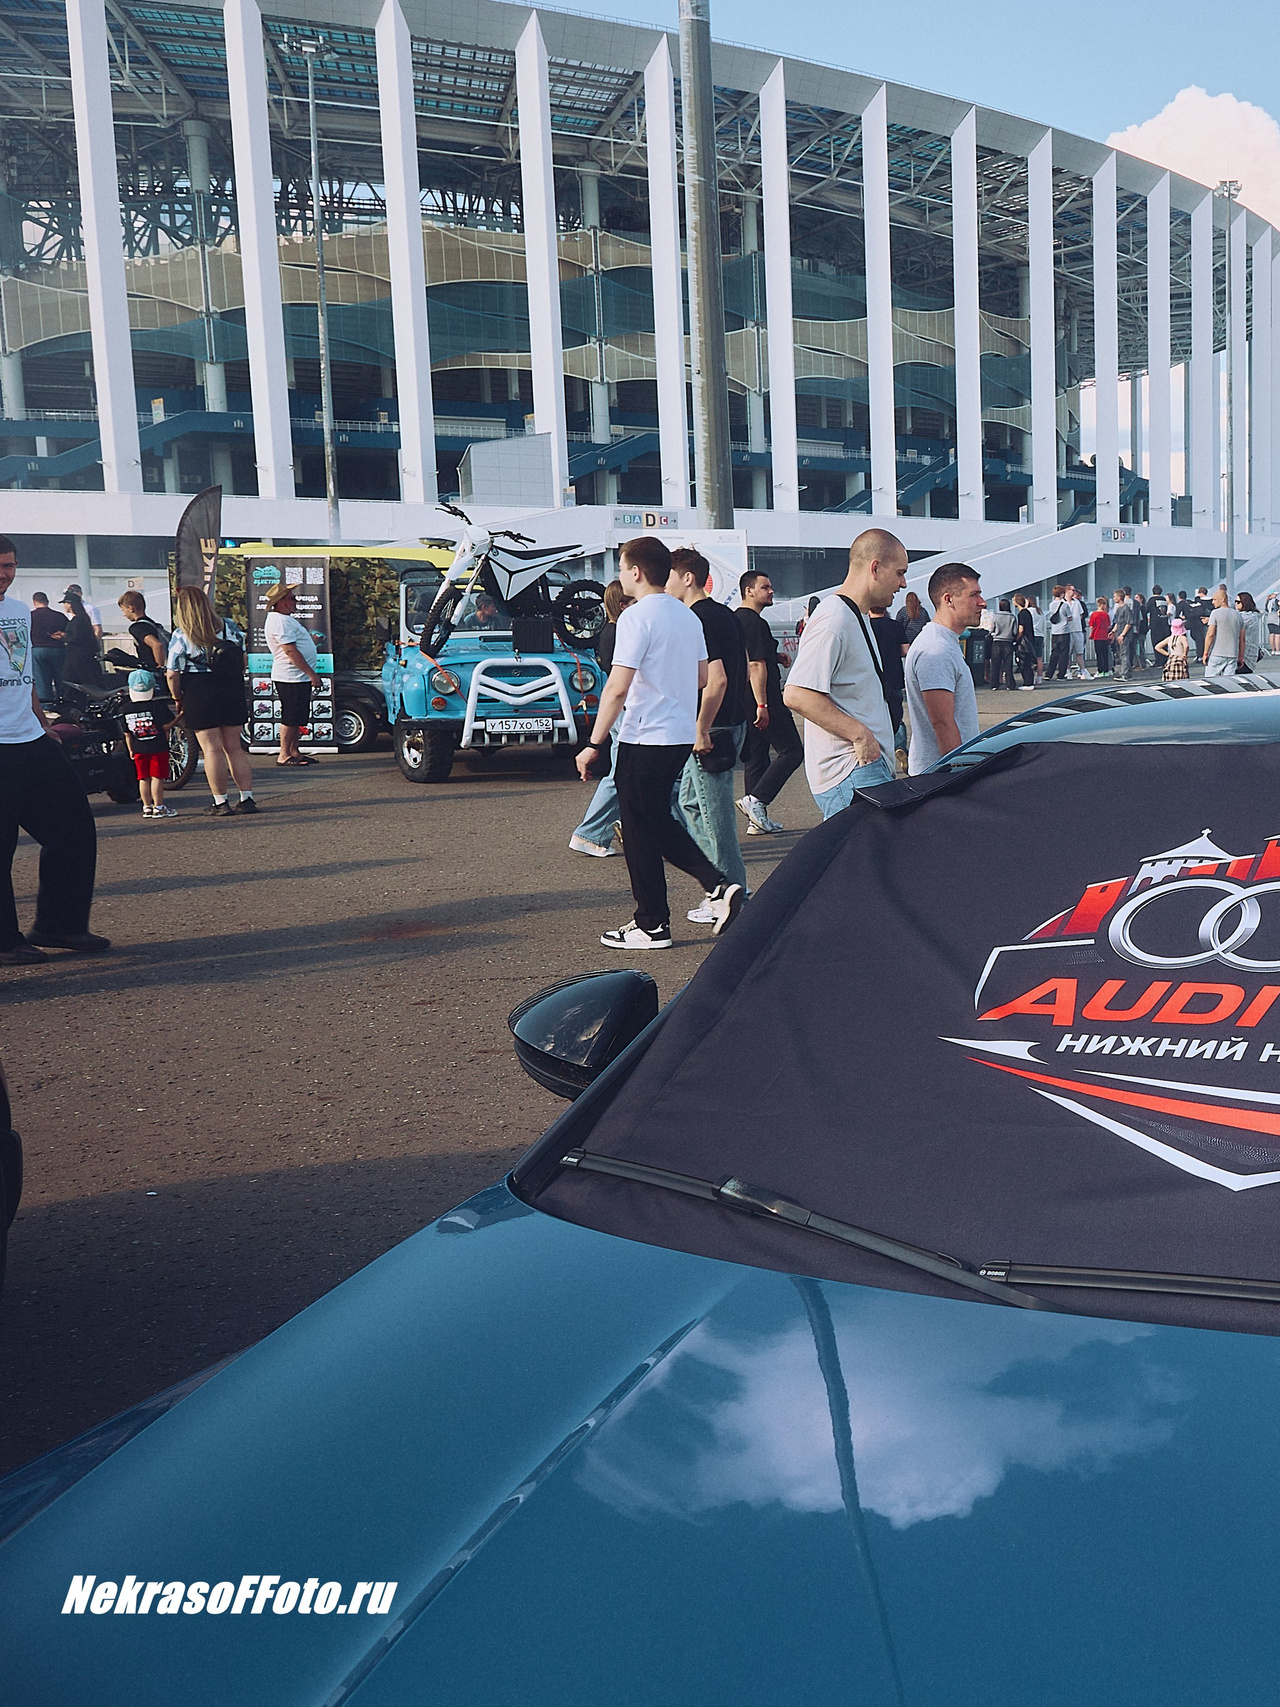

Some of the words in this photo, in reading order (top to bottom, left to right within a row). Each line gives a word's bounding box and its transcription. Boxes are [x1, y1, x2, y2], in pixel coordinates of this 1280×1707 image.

[645, 513, 656, 527] D
[534, 719, 551, 727] 152
[1056, 1033, 1247, 1063] НИЖНИЙ
